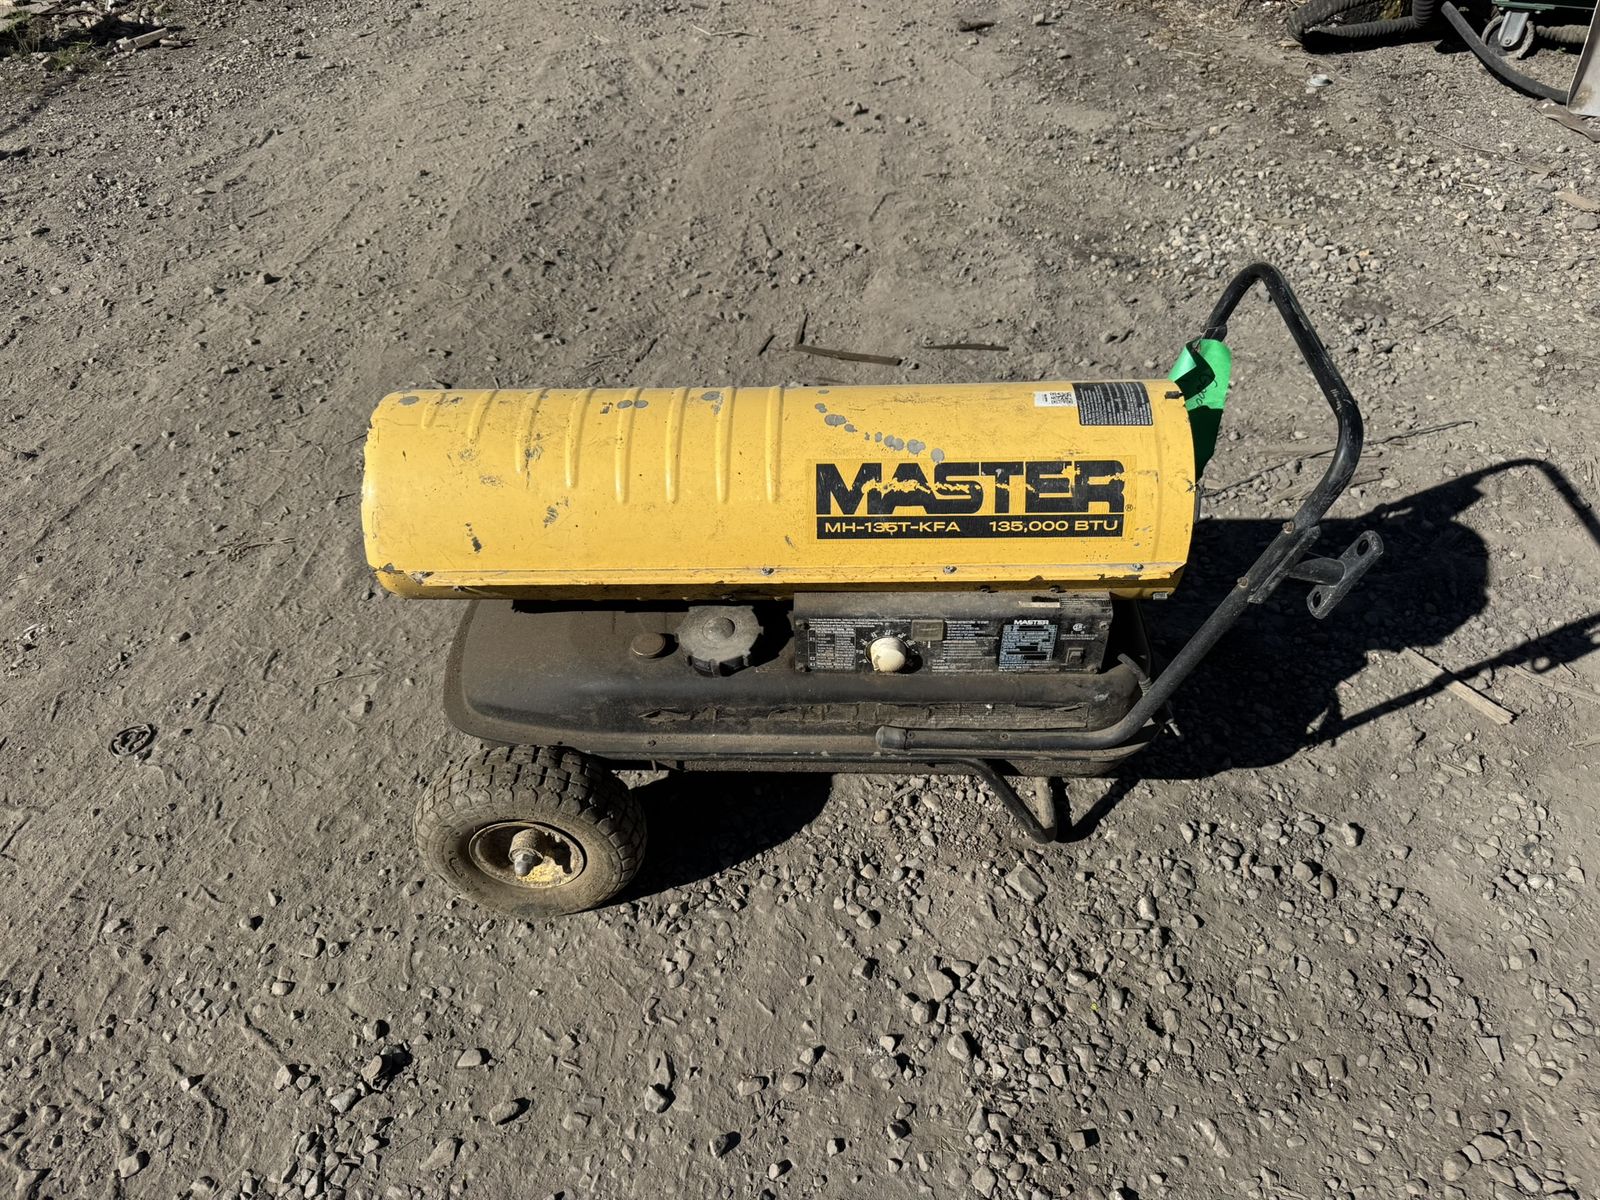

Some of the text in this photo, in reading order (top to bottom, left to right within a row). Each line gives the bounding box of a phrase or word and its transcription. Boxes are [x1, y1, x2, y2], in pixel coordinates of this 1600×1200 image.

[815, 459, 1125, 515] MASTER
[824, 519, 1119, 533] MH-135T-KFA 135,000 BTU
